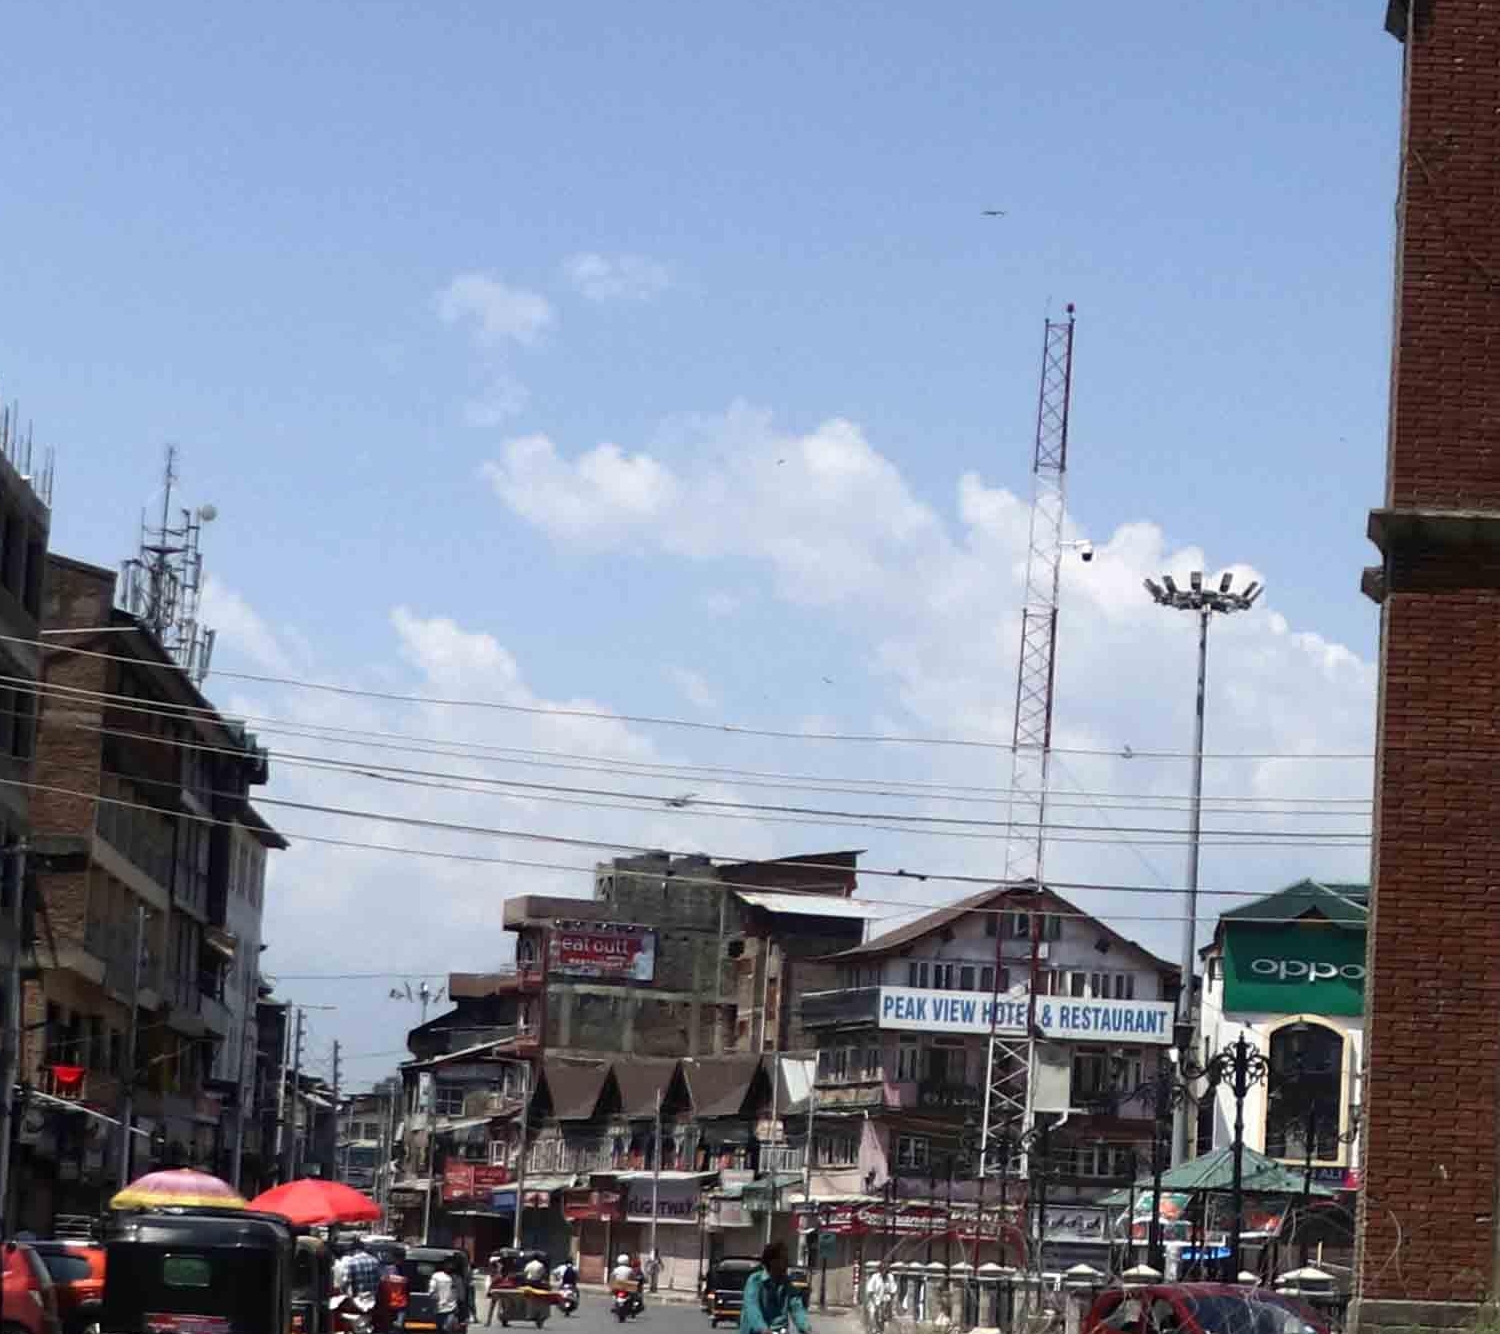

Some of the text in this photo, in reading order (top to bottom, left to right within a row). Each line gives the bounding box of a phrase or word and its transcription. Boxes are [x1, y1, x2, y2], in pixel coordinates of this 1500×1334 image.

[1251, 957, 1366, 983] oppo
[883, 995, 925, 1020] PEAK
[931, 997, 976, 1024] VIEW
[1041, 1004, 1052, 1027] &
[1059, 1005, 1168, 1033] RESTAURANT
